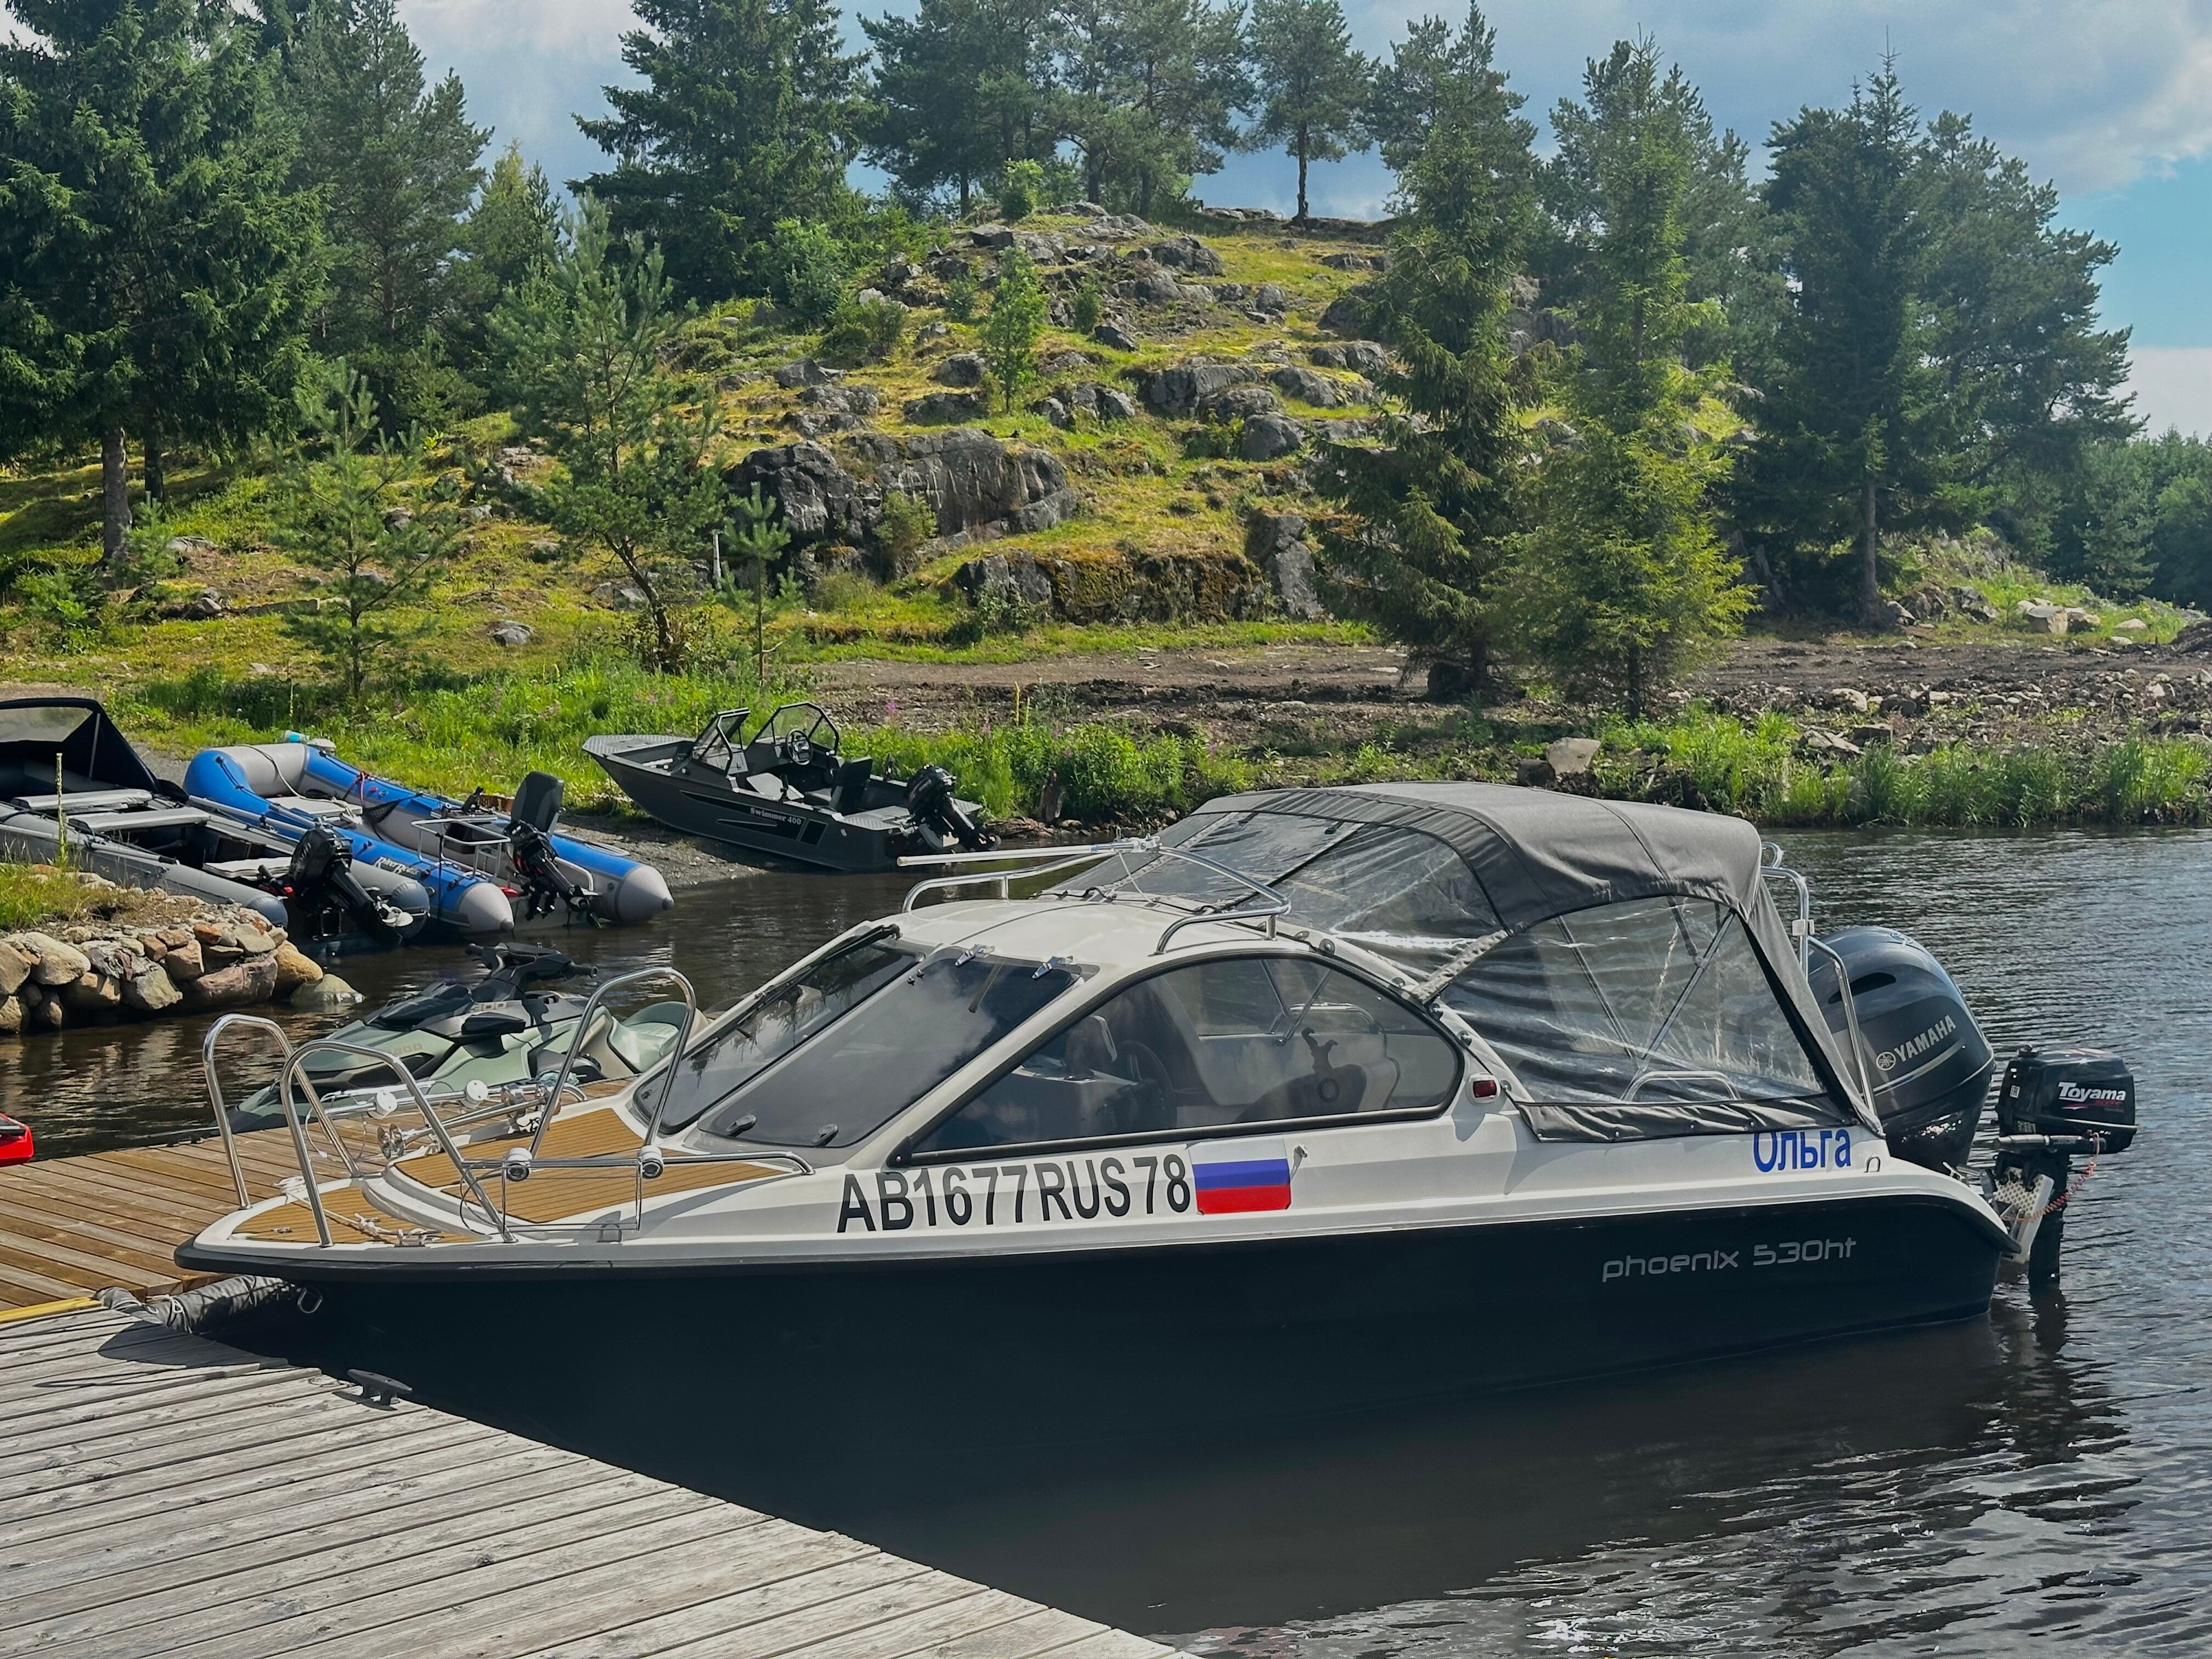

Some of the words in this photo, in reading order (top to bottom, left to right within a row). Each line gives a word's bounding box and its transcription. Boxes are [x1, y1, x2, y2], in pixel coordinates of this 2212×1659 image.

[750, 807, 787, 822] Swimmer
[787, 816, 802, 825] 400
[1894, 1014, 1957, 1062] YAMAHA
[2058, 1081, 2126, 1103] Toyama
[1753, 1128, 1857, 1173] Ольга
[837, 1154, 1190, 1233] AB1677RUS78
[1602, 1249, 1740, 1283] phoenix
[1753, 1237, 1857, 1266] 530ht
